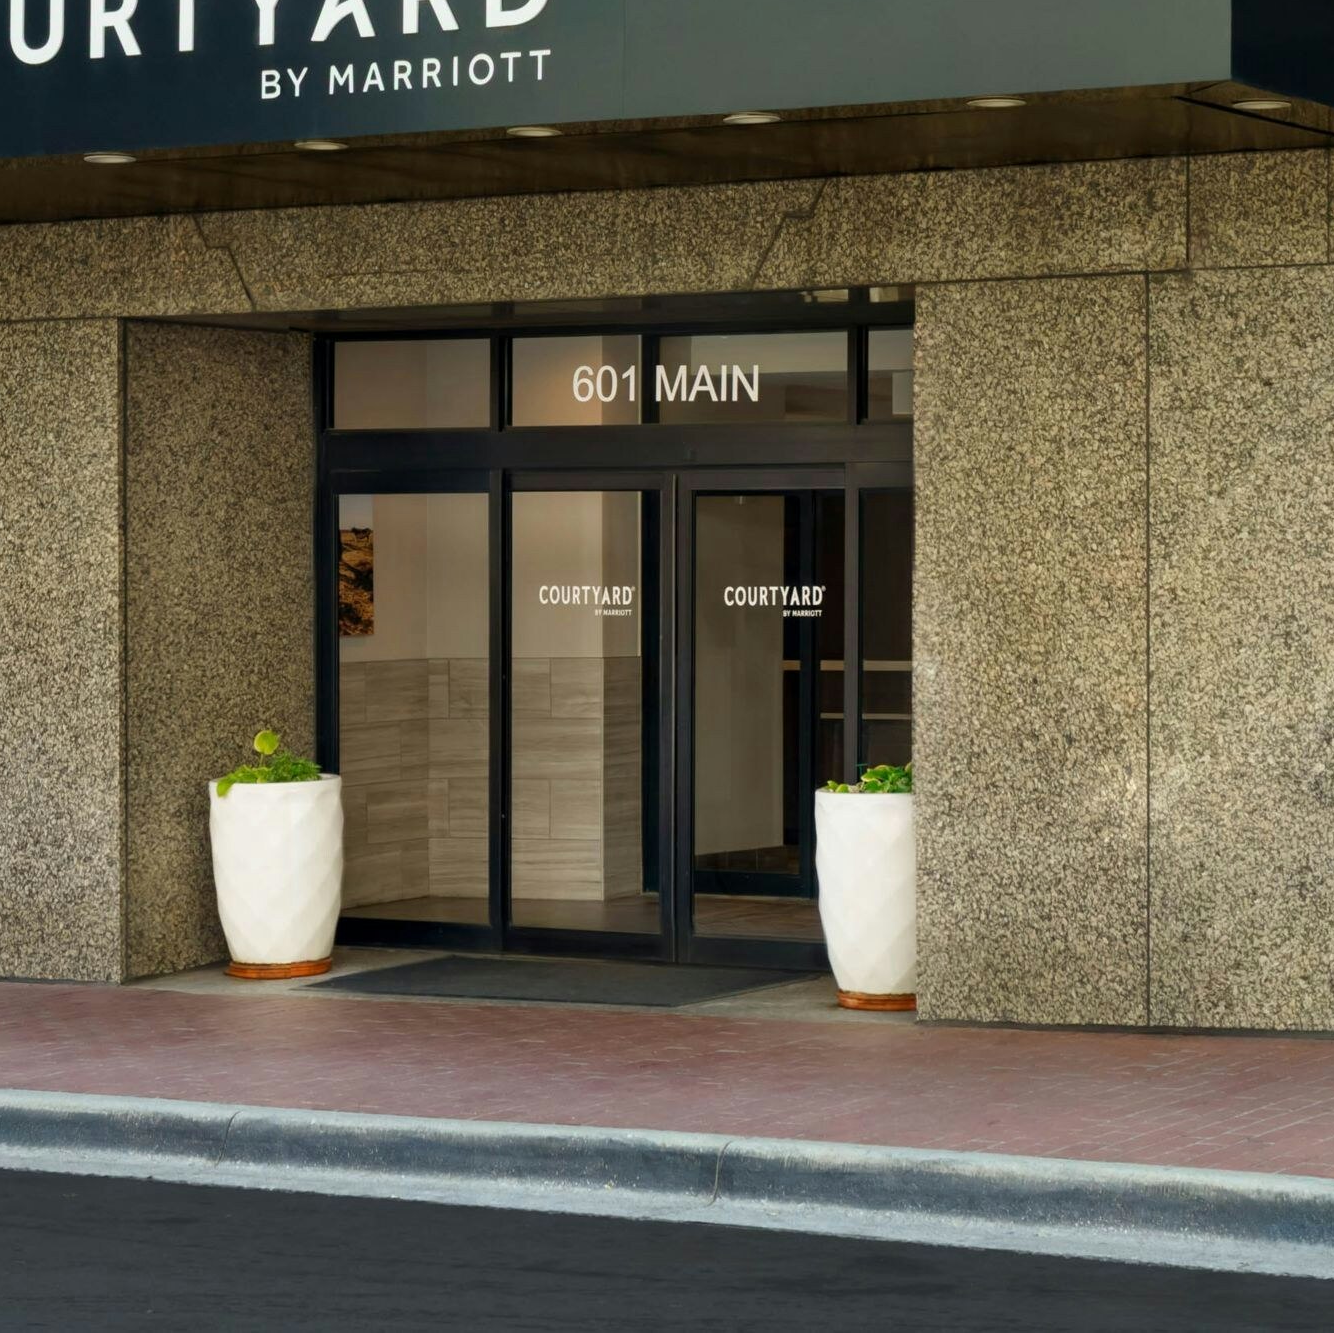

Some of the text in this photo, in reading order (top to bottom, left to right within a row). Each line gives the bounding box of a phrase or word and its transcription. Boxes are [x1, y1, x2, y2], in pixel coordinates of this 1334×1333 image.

[260, 49, 552, 100] BY MARRIOTT
[572, 364, 760, 403] 601 MAIN
[602, 608, 633, 616] MARRIOTT
[782, 609, 823, 617] BY MARRIOTT
